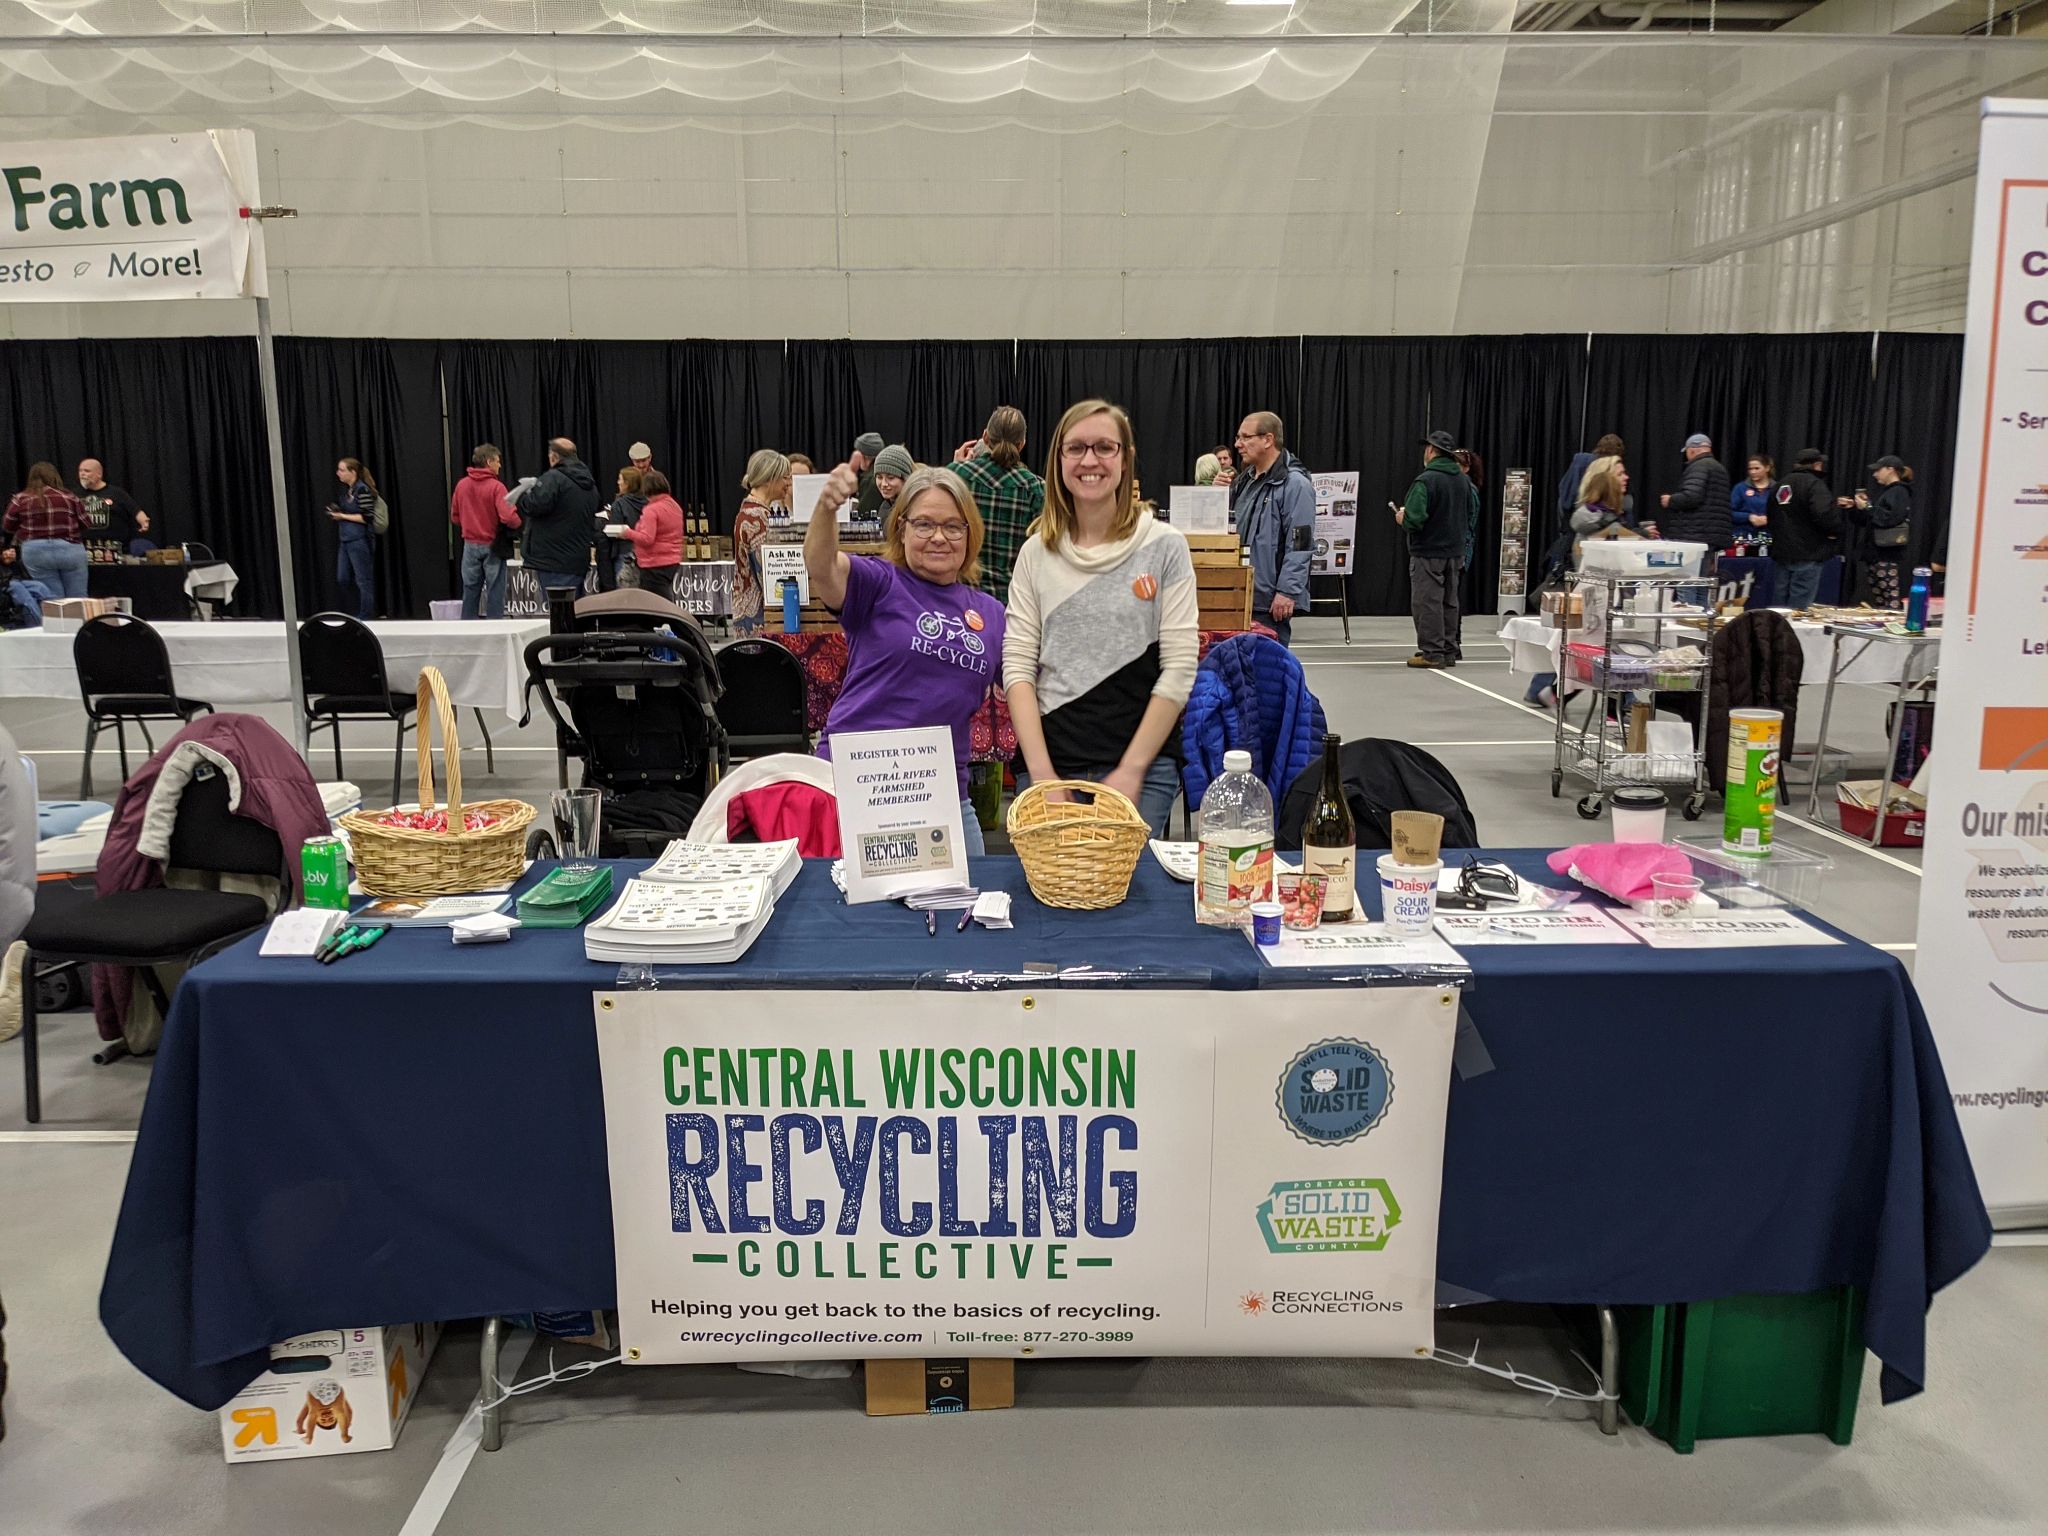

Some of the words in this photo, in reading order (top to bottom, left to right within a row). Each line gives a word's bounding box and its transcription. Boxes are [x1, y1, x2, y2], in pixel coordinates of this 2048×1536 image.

[2, 166, 193, 231] Farm
[108, 249, 202, 277] More!
[768, 550, 785, 559] Ask
[787, 550, 802, 559] Me
[910, 636, 988, 676] RE-CYCLE
[850, 749, 900, 761] REGISTER
[901, 748, 916, 757] TO
[917, 745, 938, 755] WIN
[892, 761, 899, 769] A
[856, 772, 901, 784] CENTRAL
[903, 769, 938, 780] RIVERS
[872, 782, 925, 795] FARMSHED
[867, 792, 933, 807] MEMBERSHIP
[1962, 803, 2008, 837] Our
[863, 835, 887, 846] CENTRAL
[887, 832, 917, 842] WISCONSIN
[864, 841, 919, 862] RECYCLING
[873, 858, 913, 868] COLLECTIVE
[1978, 864, 1997, 876] We
[1394, 878, 1430, 894] Daisy
[1964, 888, 2021, 898] resources
[2023, 886, 2044, 897] and
[1397, 896, 1428, 907] SOUR
[1393, 906, 1430, 916] CREAM
[1968, 907, 2001, 919] waste
[1502, 916, 1541, 924] TO
[1697, 921, 1737, 929] TO
[1296, 937, 1337, 945] TO
[1341, 936, 1403, 944] BIN.
[1299, 1048, 1328, 1068] WE'LL
[1331, 1046, 1351, 1056] TELL
[1354, 1048, 1375, 1065] YOU
[663, 1046, 866, 1108] CENTRAL
[879, 1046, 1136, 1109] WISCONSIN
[1300, 1092, 1369, 1115] WASTE
[1295, 1115, 1325, 1138] WHERE
[1327, 1129, 1342, 1139] TO
[1344, 1120, 1362, 1136] PUT
[1362, 1112, 1374, 1123] IT.
[665, 1113, 1138, 1239] RECYCLING
[1293, 1180, 1367, 1189] PORTAGE
[1284, 1191, 1370, 1216] SOLID
[1274, 1216, 1375, 1240] WASTE
[1295, 1242, 1359, 1251] COUNTY
[738, 1239, 1068, 1280] COLLECTIVE
[1272, 1290, 1374, 1303] RECYCLING
[651, 1299, 733, 1319] Helping
[739, 1304, 778, 1319] you
[785, 1302, 820, 1319] get
[825, 1302, 878, 1317] back
[884, 1303, 906, 1317] to
[912, 1303, 947, 1317] the
[953, 1303, 1023, 1318] basics
[1029, 1303, 1052, 1318] of
[1057, 1303, 1161, 1321] recycling.
[1271, 1301, 1403, 1314] CONNECTIONS
[353, 1330, 365, 1343] 5
[680, 1330, 923, 1345] cwrecyclingcollective.com
[946, 1331, 1019, 1343] Toll-free:
[1023, 1331, 1134, 1343] 877-270-3989
[284, 1339, 339, 1351] T-SHIRTS
[929, 1402, 963, 1414] prime
